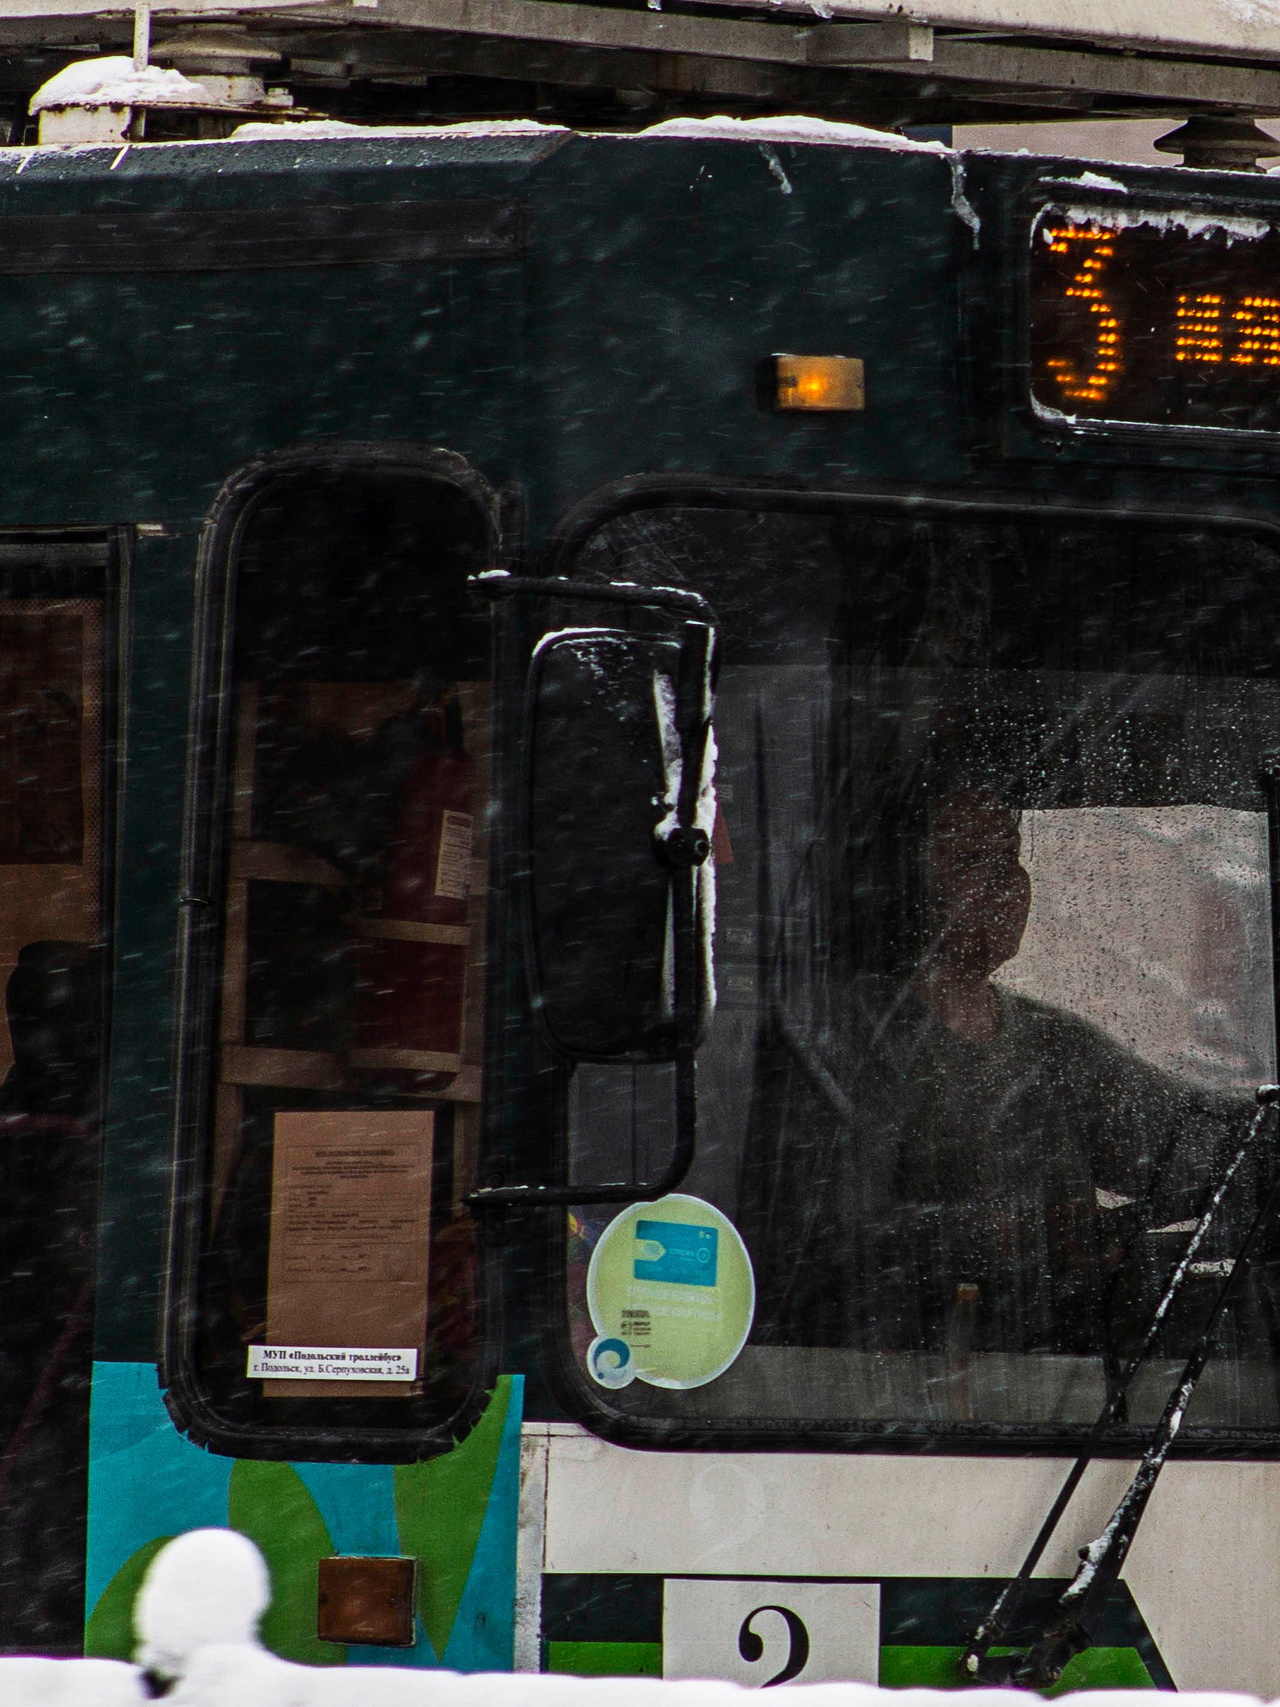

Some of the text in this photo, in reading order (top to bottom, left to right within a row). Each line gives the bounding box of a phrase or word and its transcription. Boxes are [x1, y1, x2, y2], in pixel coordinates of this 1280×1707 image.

[1047, 228, 1120, 399] 3
[263, 1350, 402, 1364] МУП «Подольский троллейбус»
[253, 1364, 260, 1372] г.
[261, 1363, 302, 1373] Подольск,
